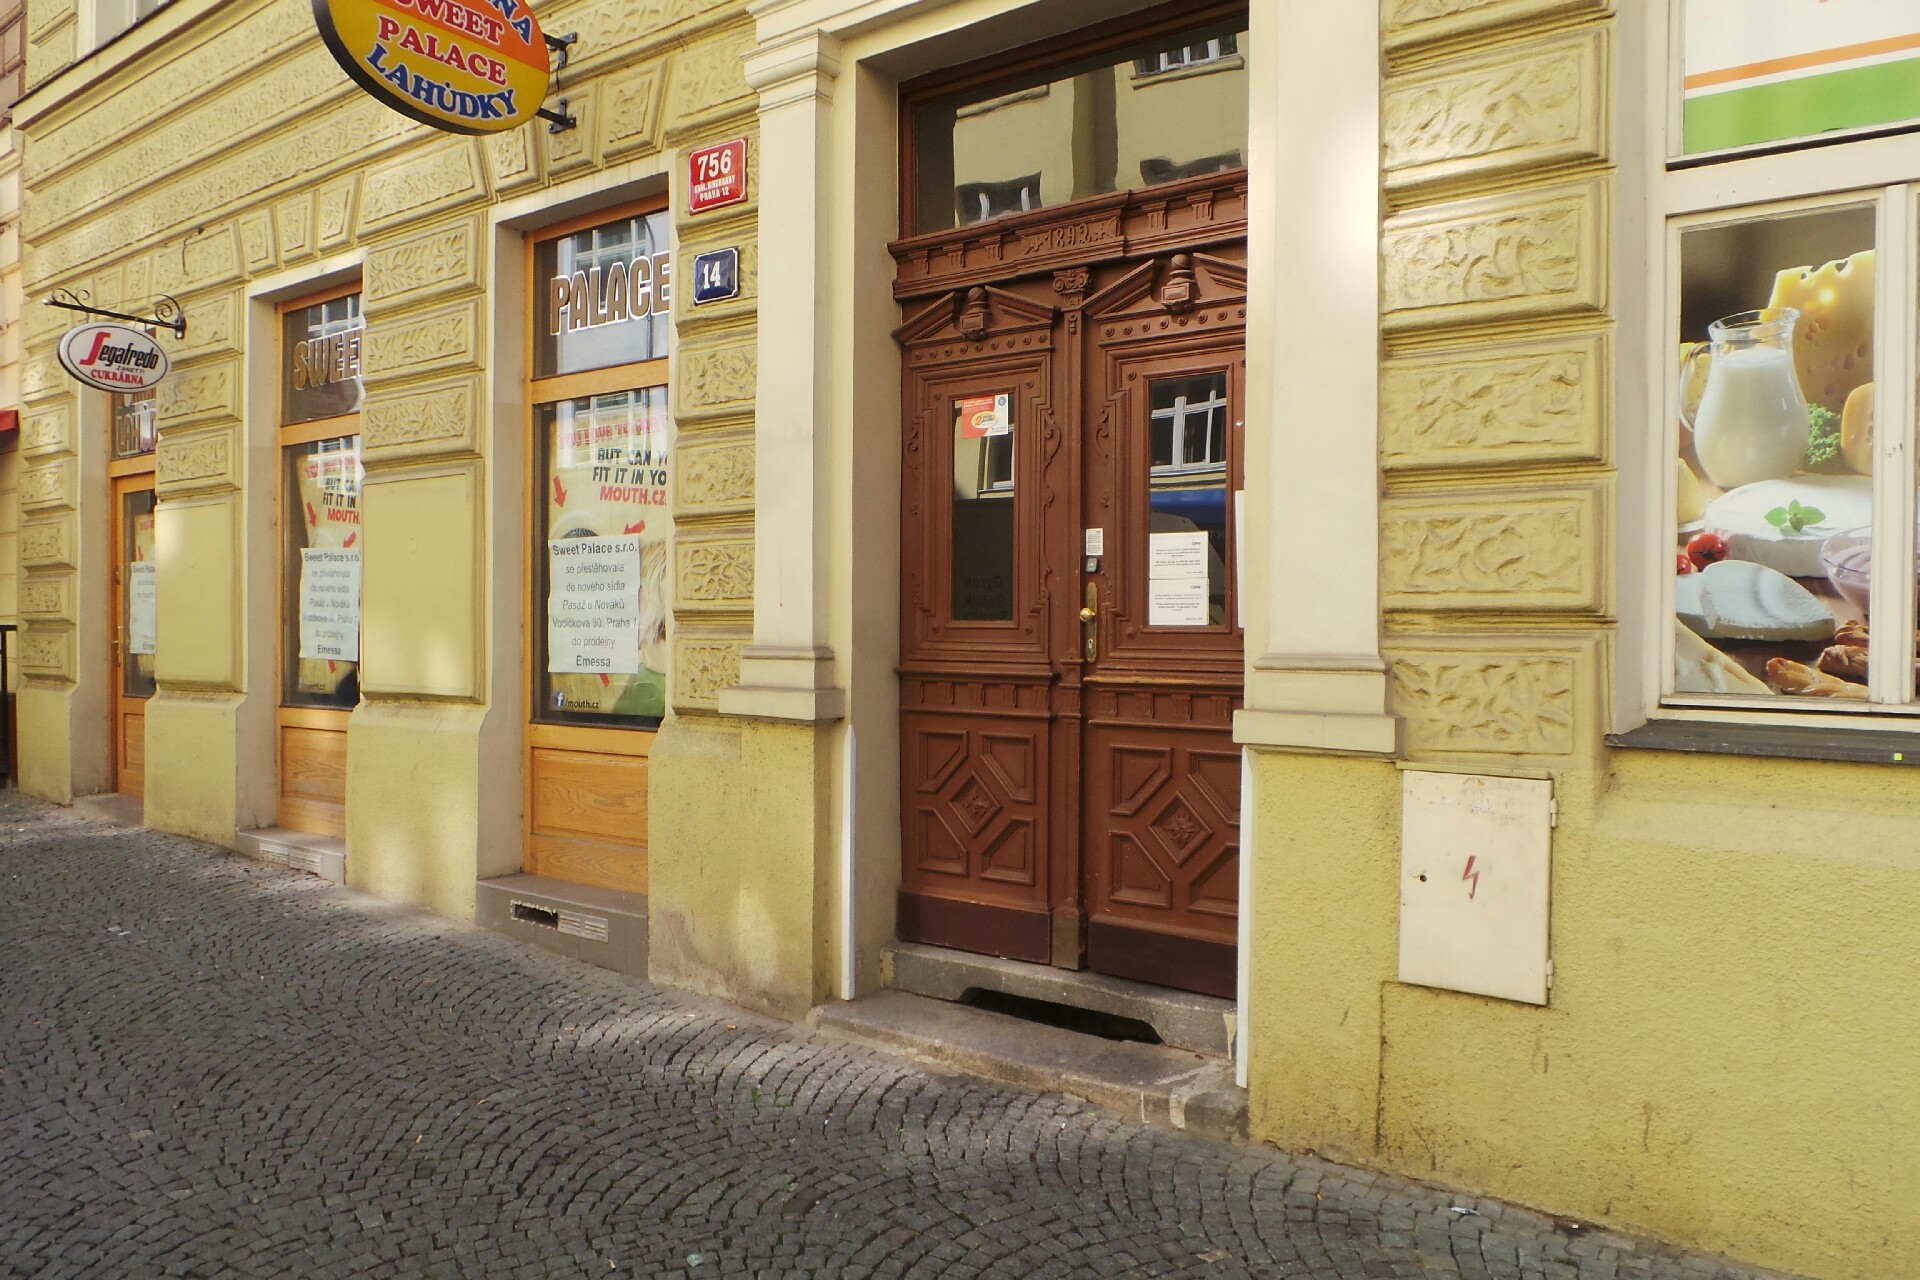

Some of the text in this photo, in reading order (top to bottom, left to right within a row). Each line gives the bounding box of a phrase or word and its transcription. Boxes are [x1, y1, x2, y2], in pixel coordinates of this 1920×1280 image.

[377, 15, 507, 86] PALACE
[697, 149, 732, 181] 756
[699, 186, 730, 202] PRAHA 12
[703, 260, 721, 290] 14
[550, 250, 670, 336] PALACE
[79, 331, 160, 370] Segafredo
[293, 327, 362, 391] SWEE
[91, 368, 144, 386] CUKRÁRNA
[597, 447, 622, 465] BUT
[627, 449, 652, 466] CAN
[592, 466, 667, 486] FIT IT IN YO
[322, 492, 357, 509] FIT IT IN
[324, 552, 344, 562] Palace
[552, 542, 638, 556] Sweet Palace s.r.o.
[565, 566, 575, 574] se
[566, 581, 576, 592] do
[606, 617, 630, 628] Praha
[317, 644, 342, 656] Emessa
[571, 636, 616, 649] do prodejny
[575, 655, 611, 667] Emessa
